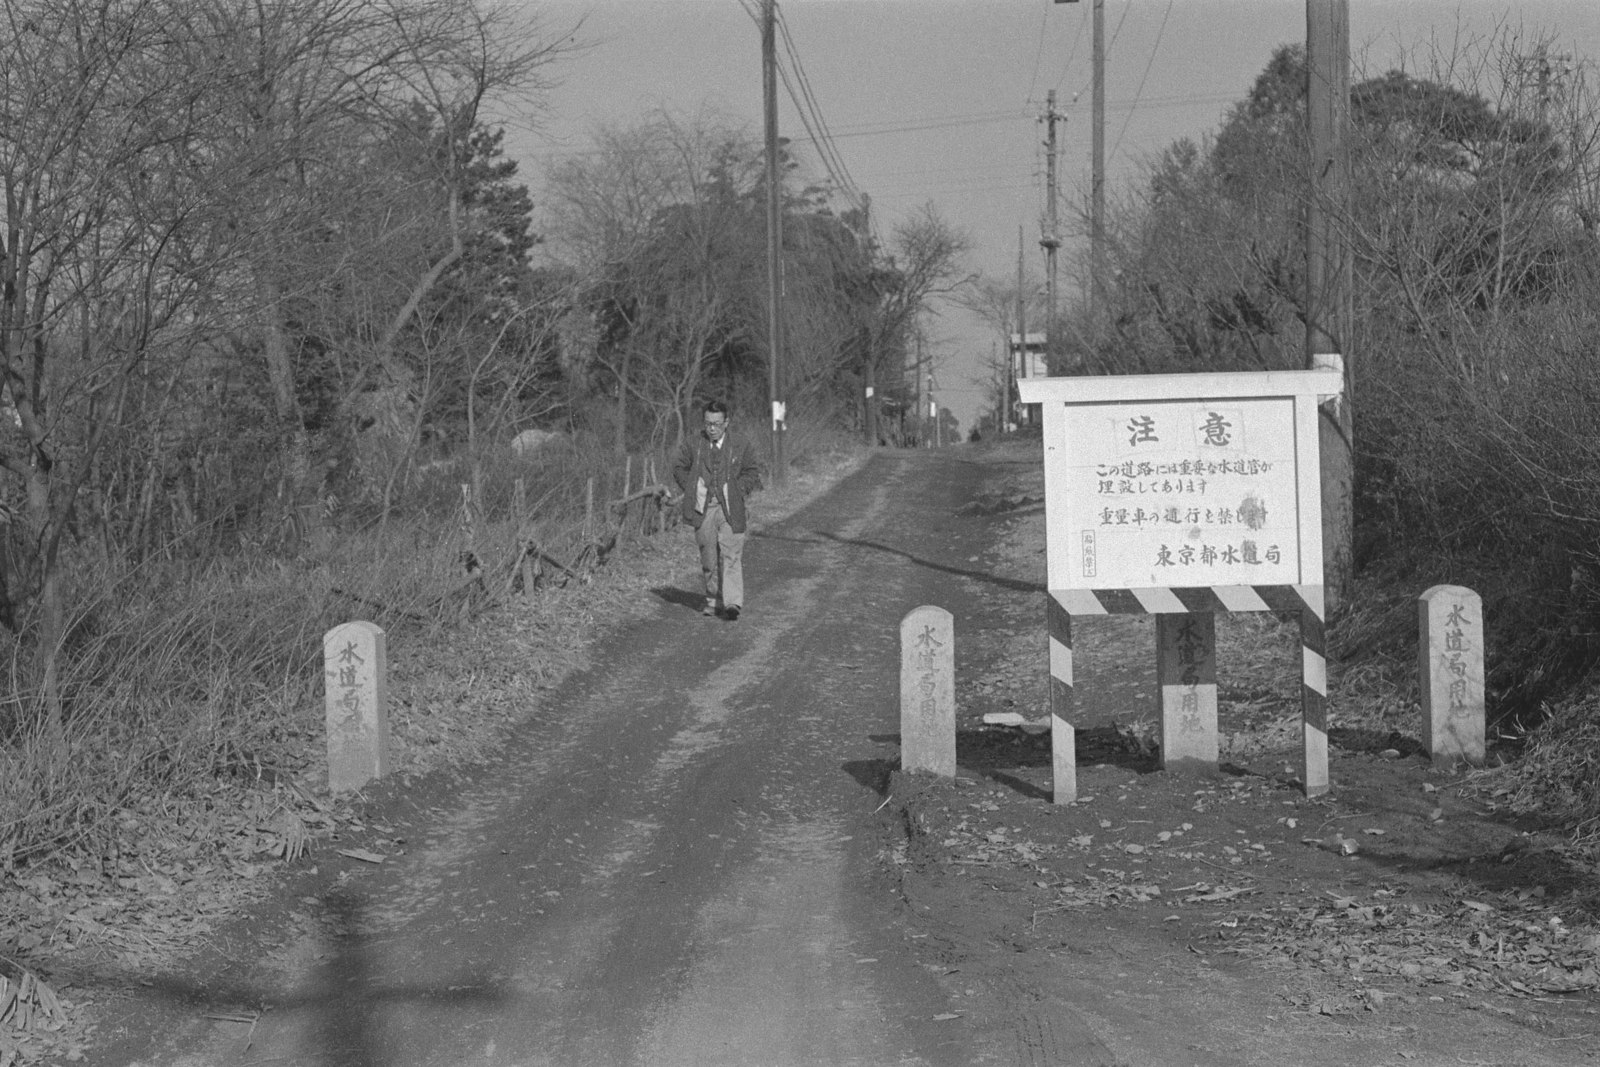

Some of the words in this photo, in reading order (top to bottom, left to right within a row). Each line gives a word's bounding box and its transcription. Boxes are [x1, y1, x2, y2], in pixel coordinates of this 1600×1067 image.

[1127, 411, 1232, 447] 注意
[1096, 458, 1273, 478] この道路には重要な水道管が
[1098, 478, 1208, 495] 埋設してあります
[1154, 543, 1281, 567] 東京都水道局
